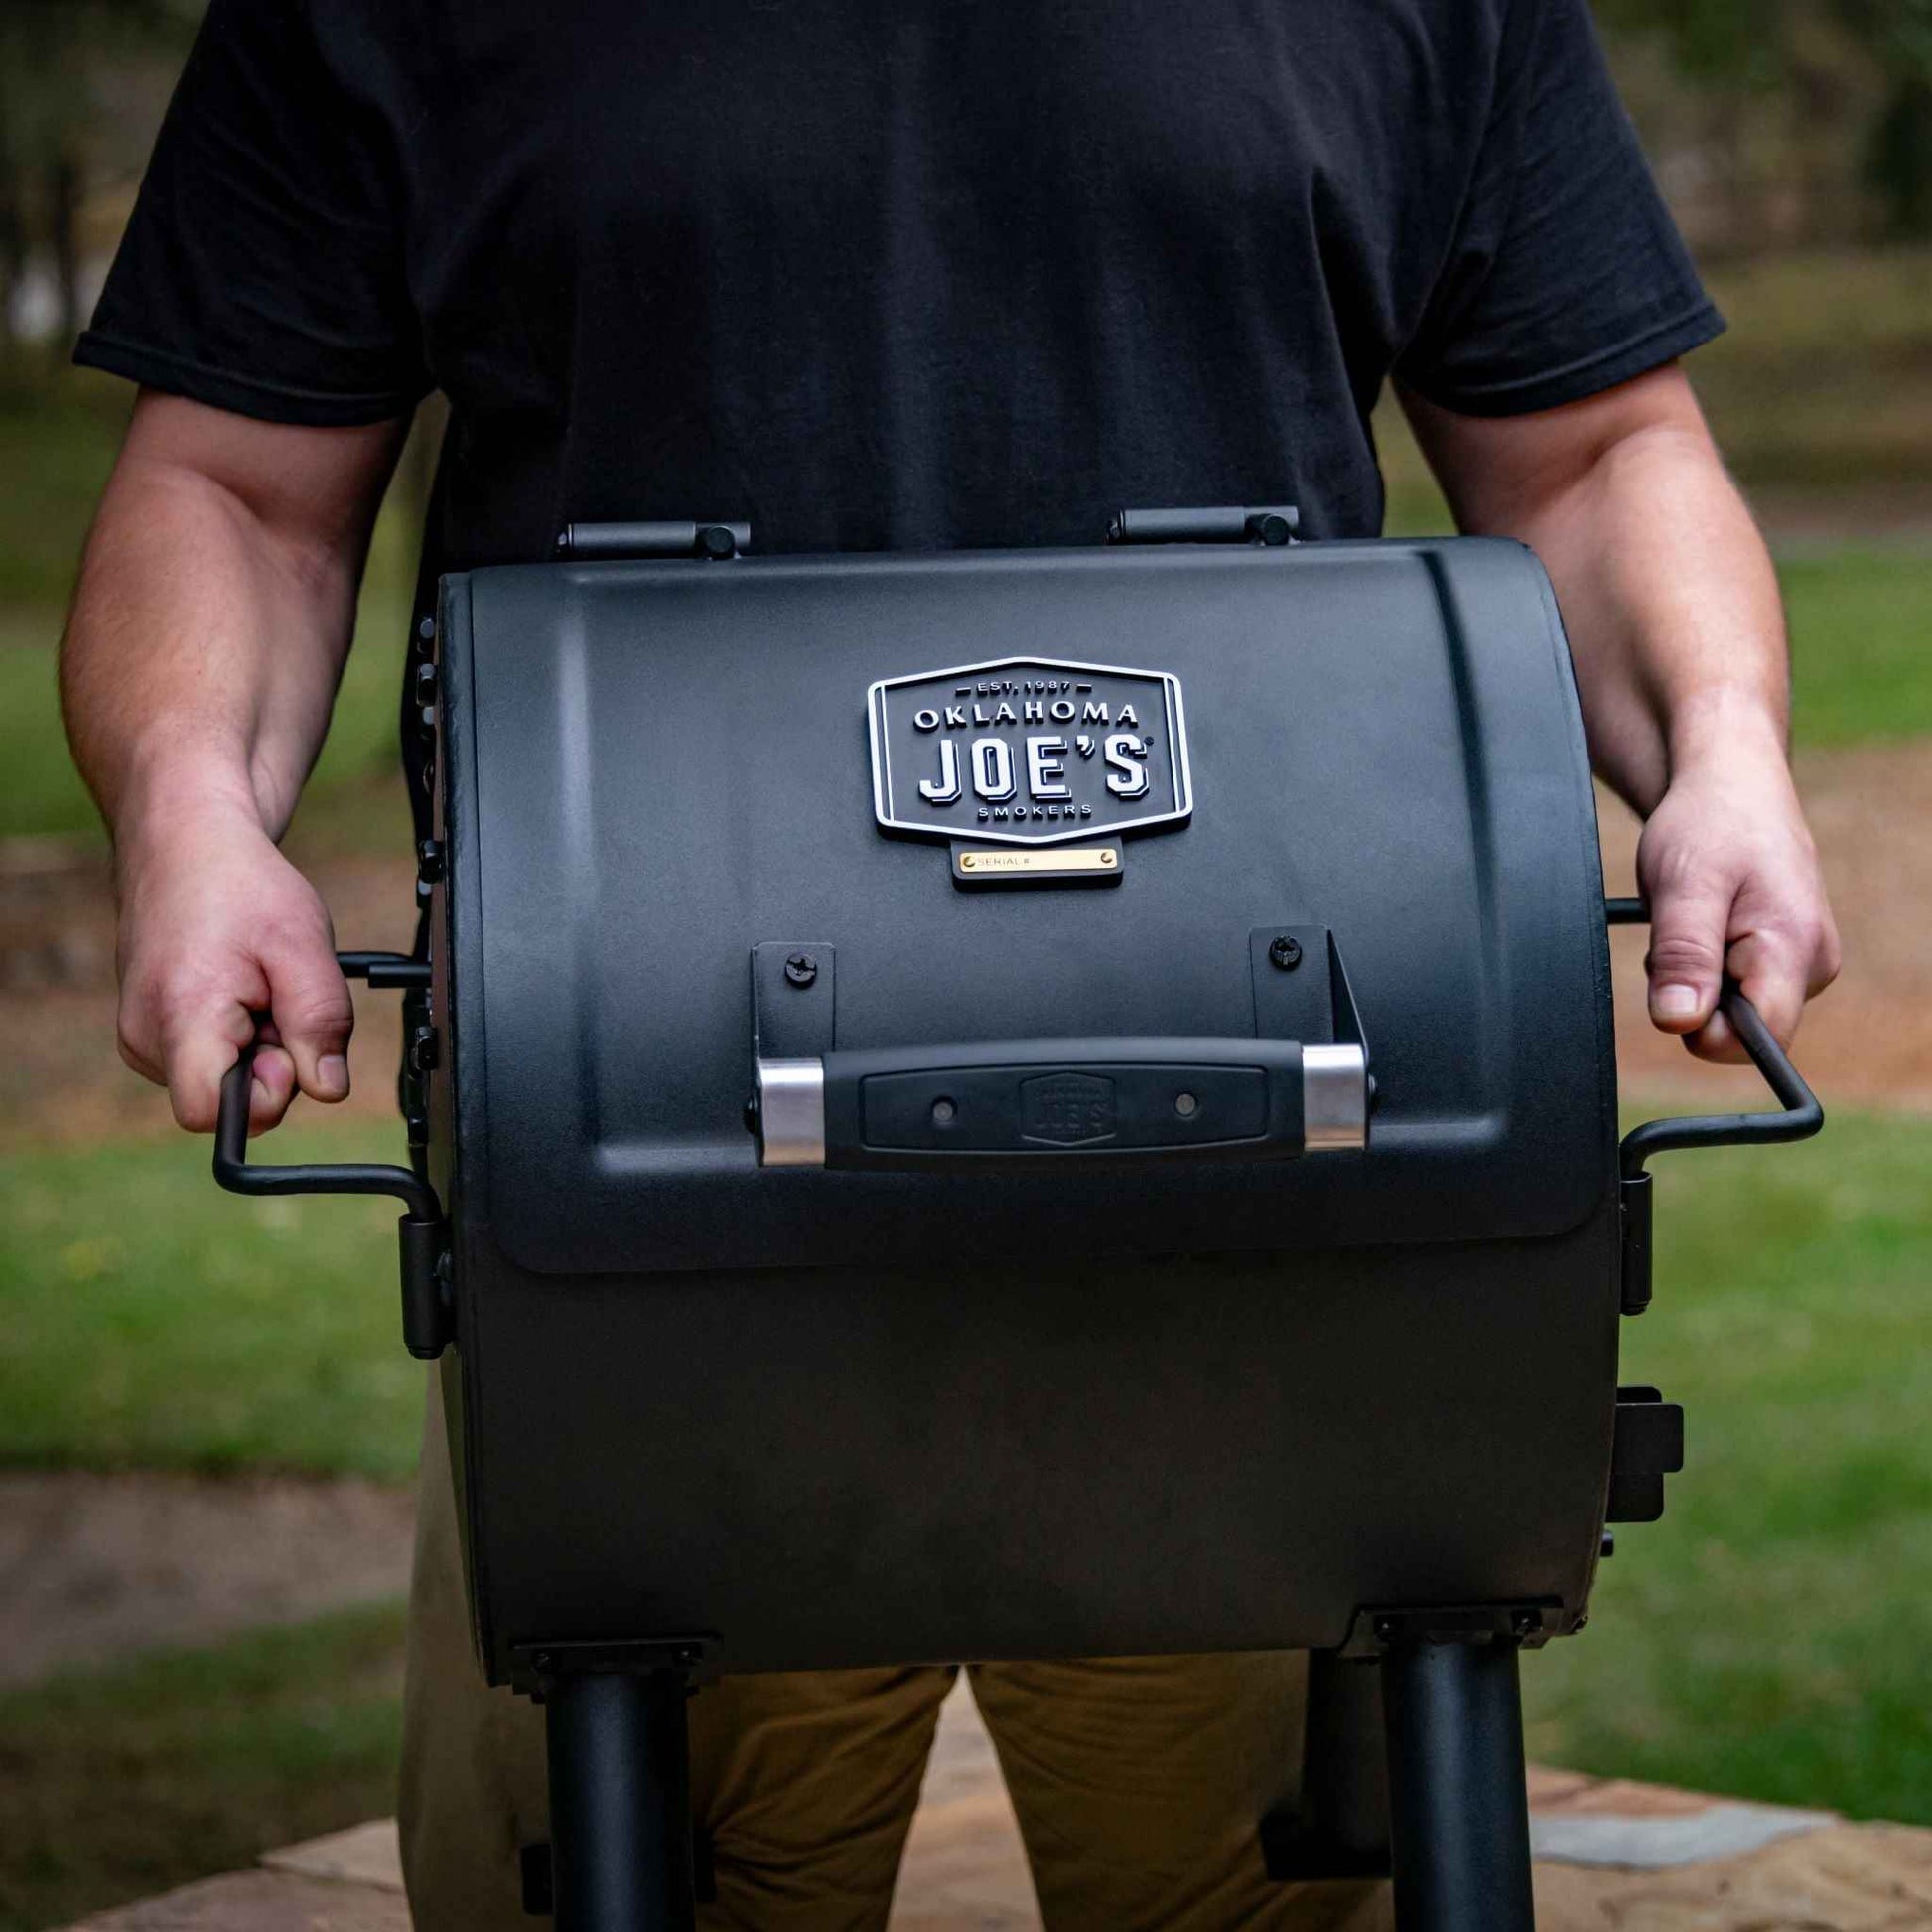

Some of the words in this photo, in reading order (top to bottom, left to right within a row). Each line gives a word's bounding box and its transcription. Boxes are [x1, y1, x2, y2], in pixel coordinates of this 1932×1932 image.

[1025, 680, 1070, 692] 1987
[913, 701, 1139, 731] OKLAHOMA
[918, 734, 1150, 802] JOE'S
[978, 804, 1092, 819] SMOKERS
